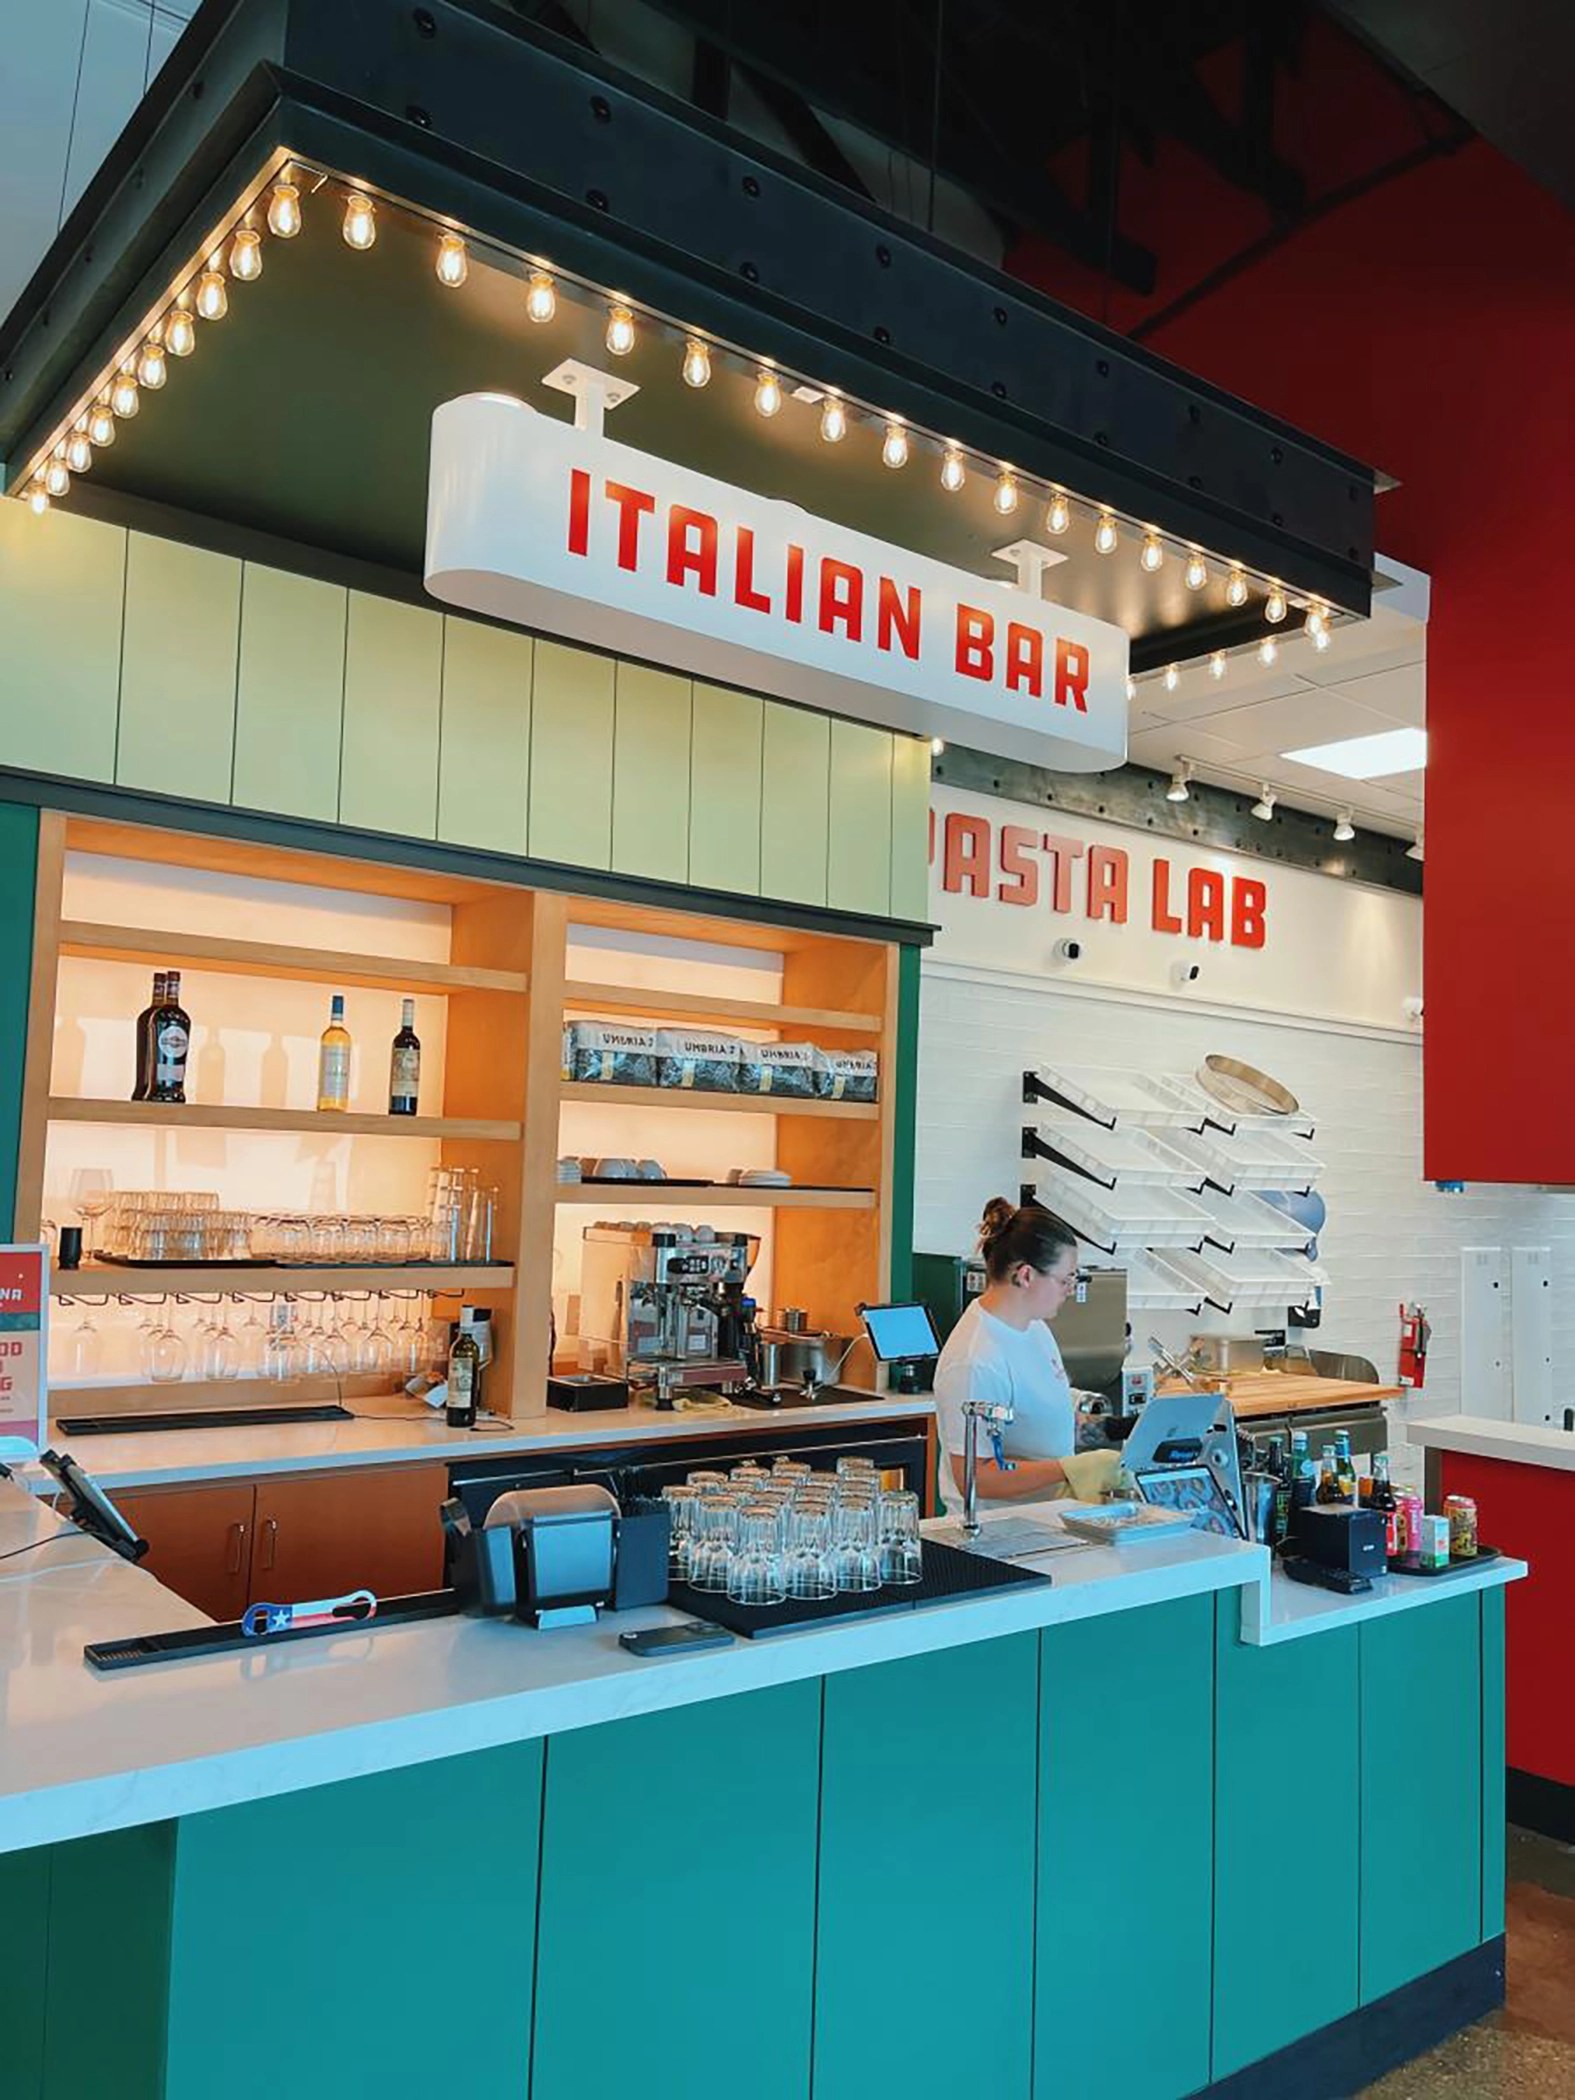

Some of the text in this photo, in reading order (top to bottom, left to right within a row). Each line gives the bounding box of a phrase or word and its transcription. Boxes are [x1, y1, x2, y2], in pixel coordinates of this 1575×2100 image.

[567, 468, 1089, 713] ITALIAN BAR
[929, 807, 1267, 950] ASTA LAB
[602, 1032, 646, 1048] UMBRIA
[684, 1041, 727, 1055] UMBRIA
